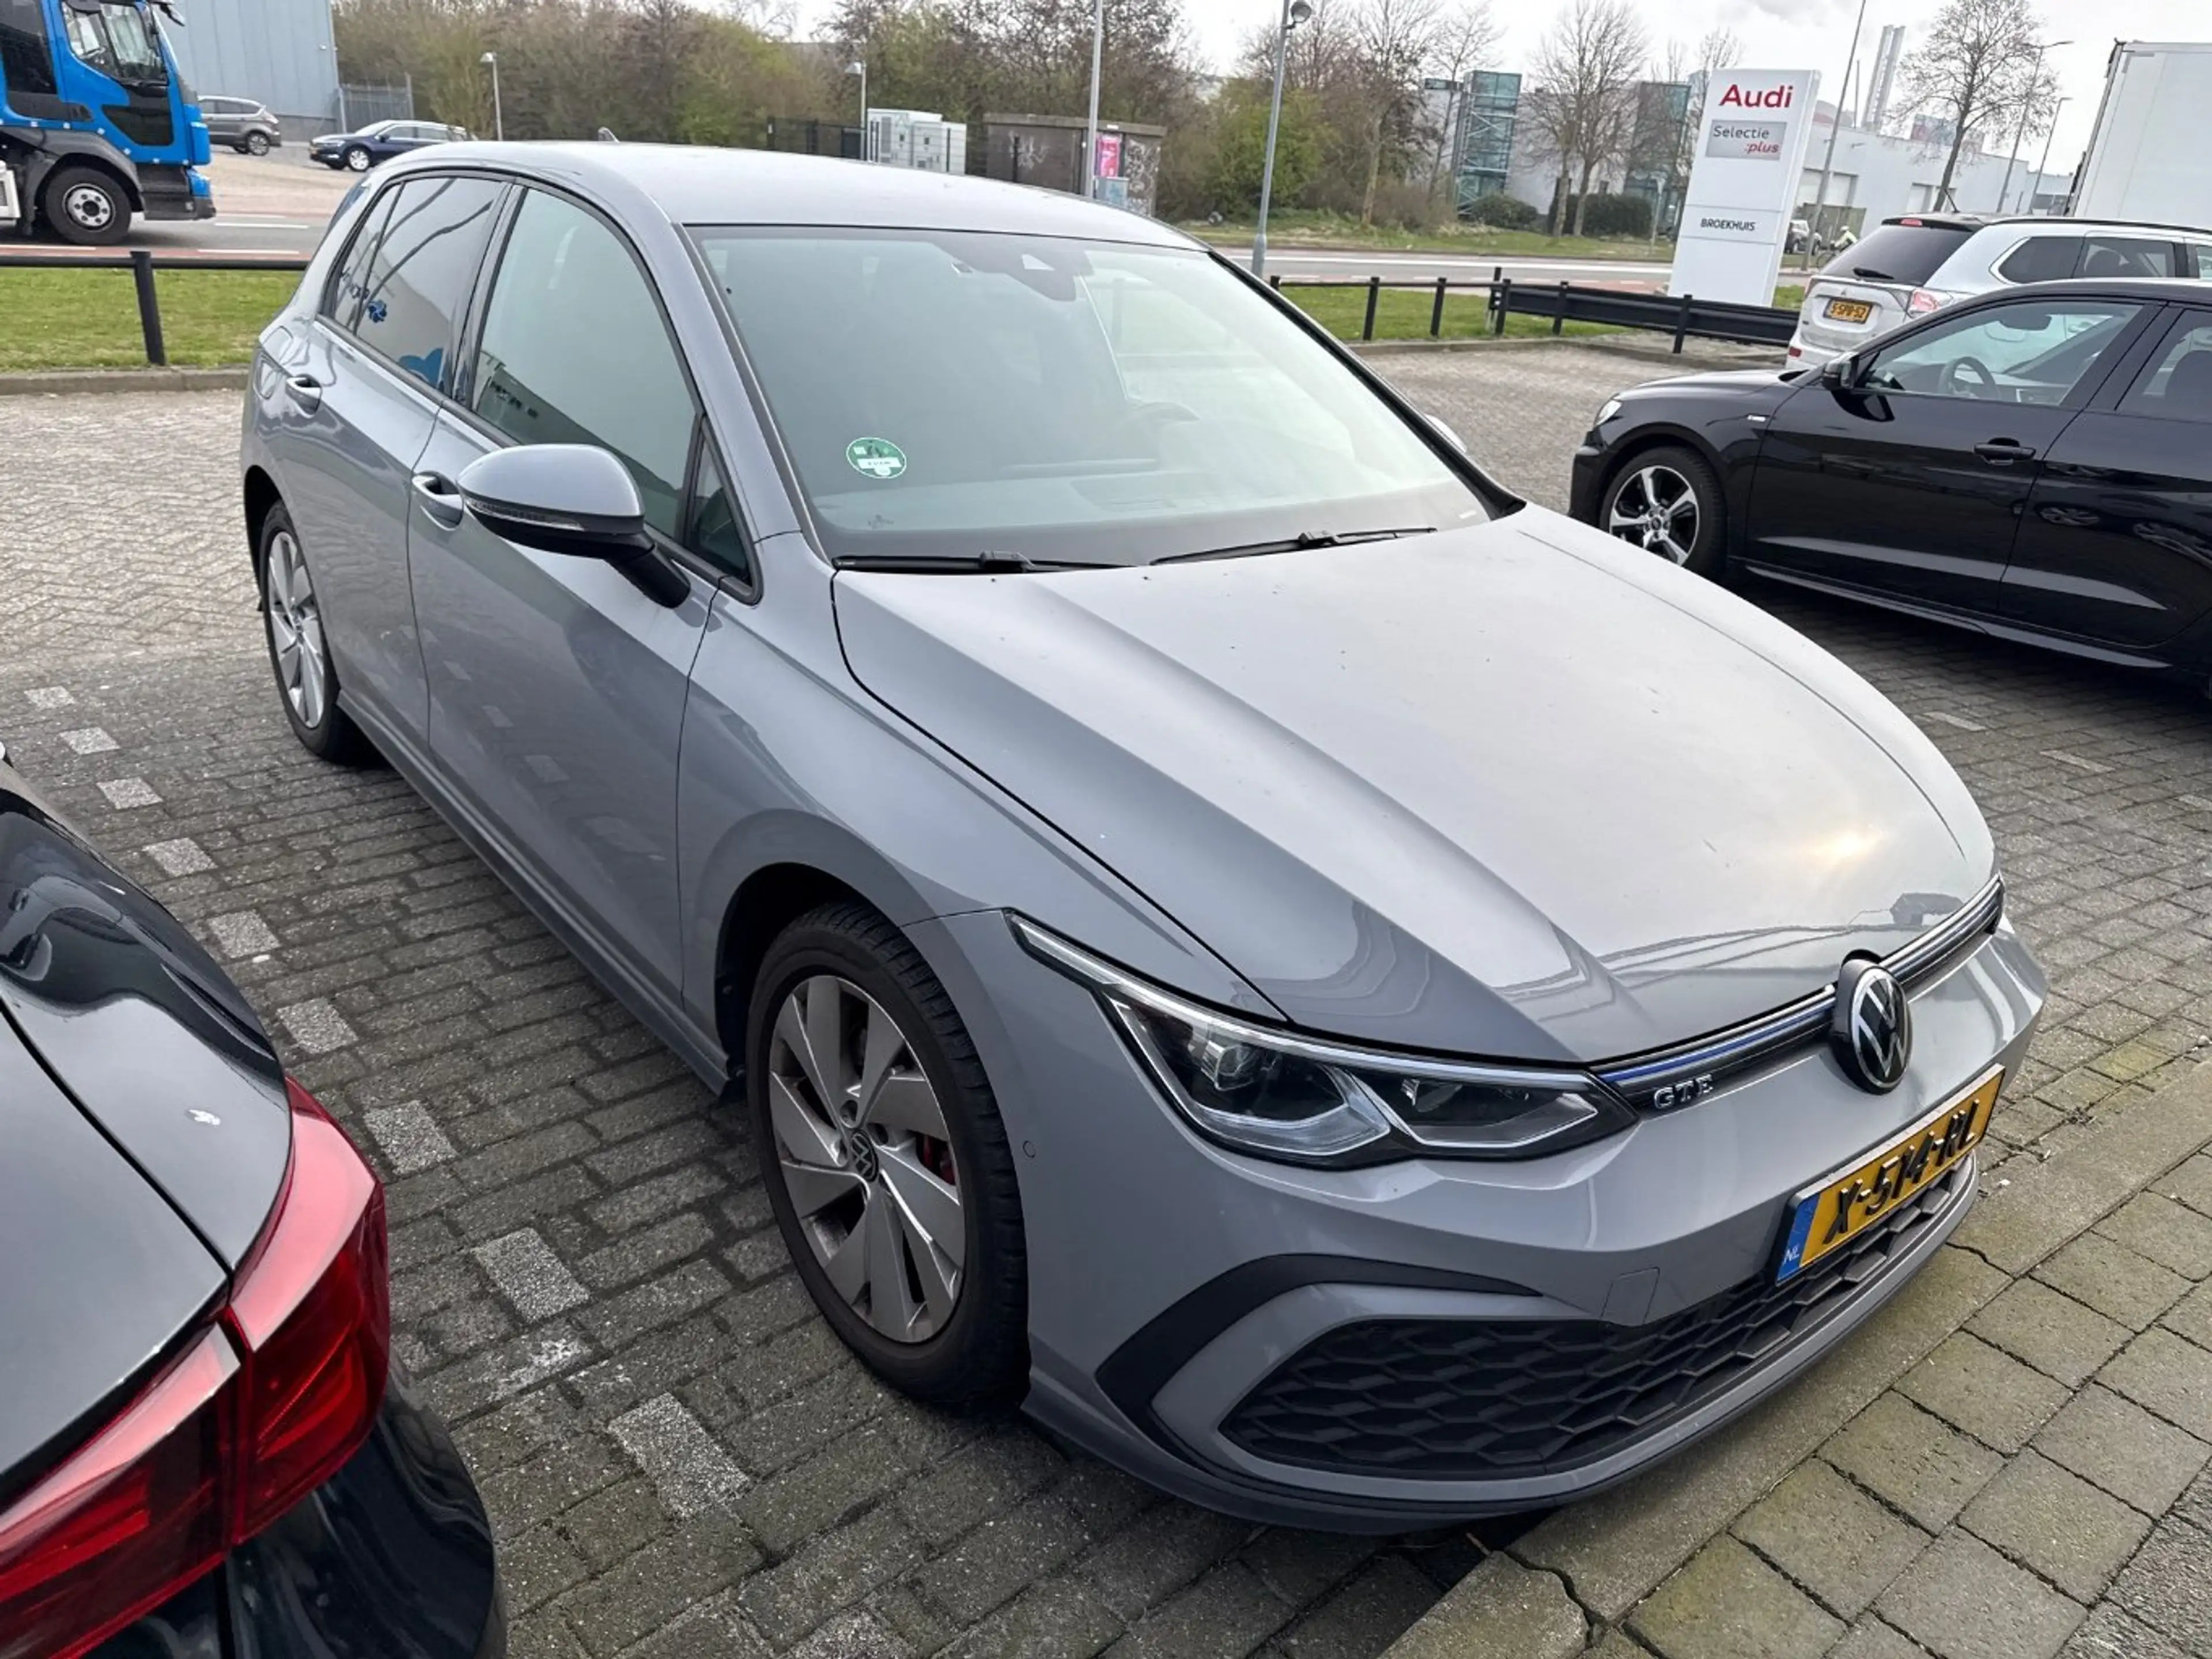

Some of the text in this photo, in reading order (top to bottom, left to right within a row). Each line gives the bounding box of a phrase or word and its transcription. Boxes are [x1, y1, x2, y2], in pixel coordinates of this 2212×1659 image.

[1719, 84, 1793, 108] Audi
[1713, 125, 1769, 139] Selectie
[1700, 218, 1756, 231] BROEKHUIS
[1654, 1074, 1714, 1109] GTE
[1782, 1244, 1800, 1266] NL
